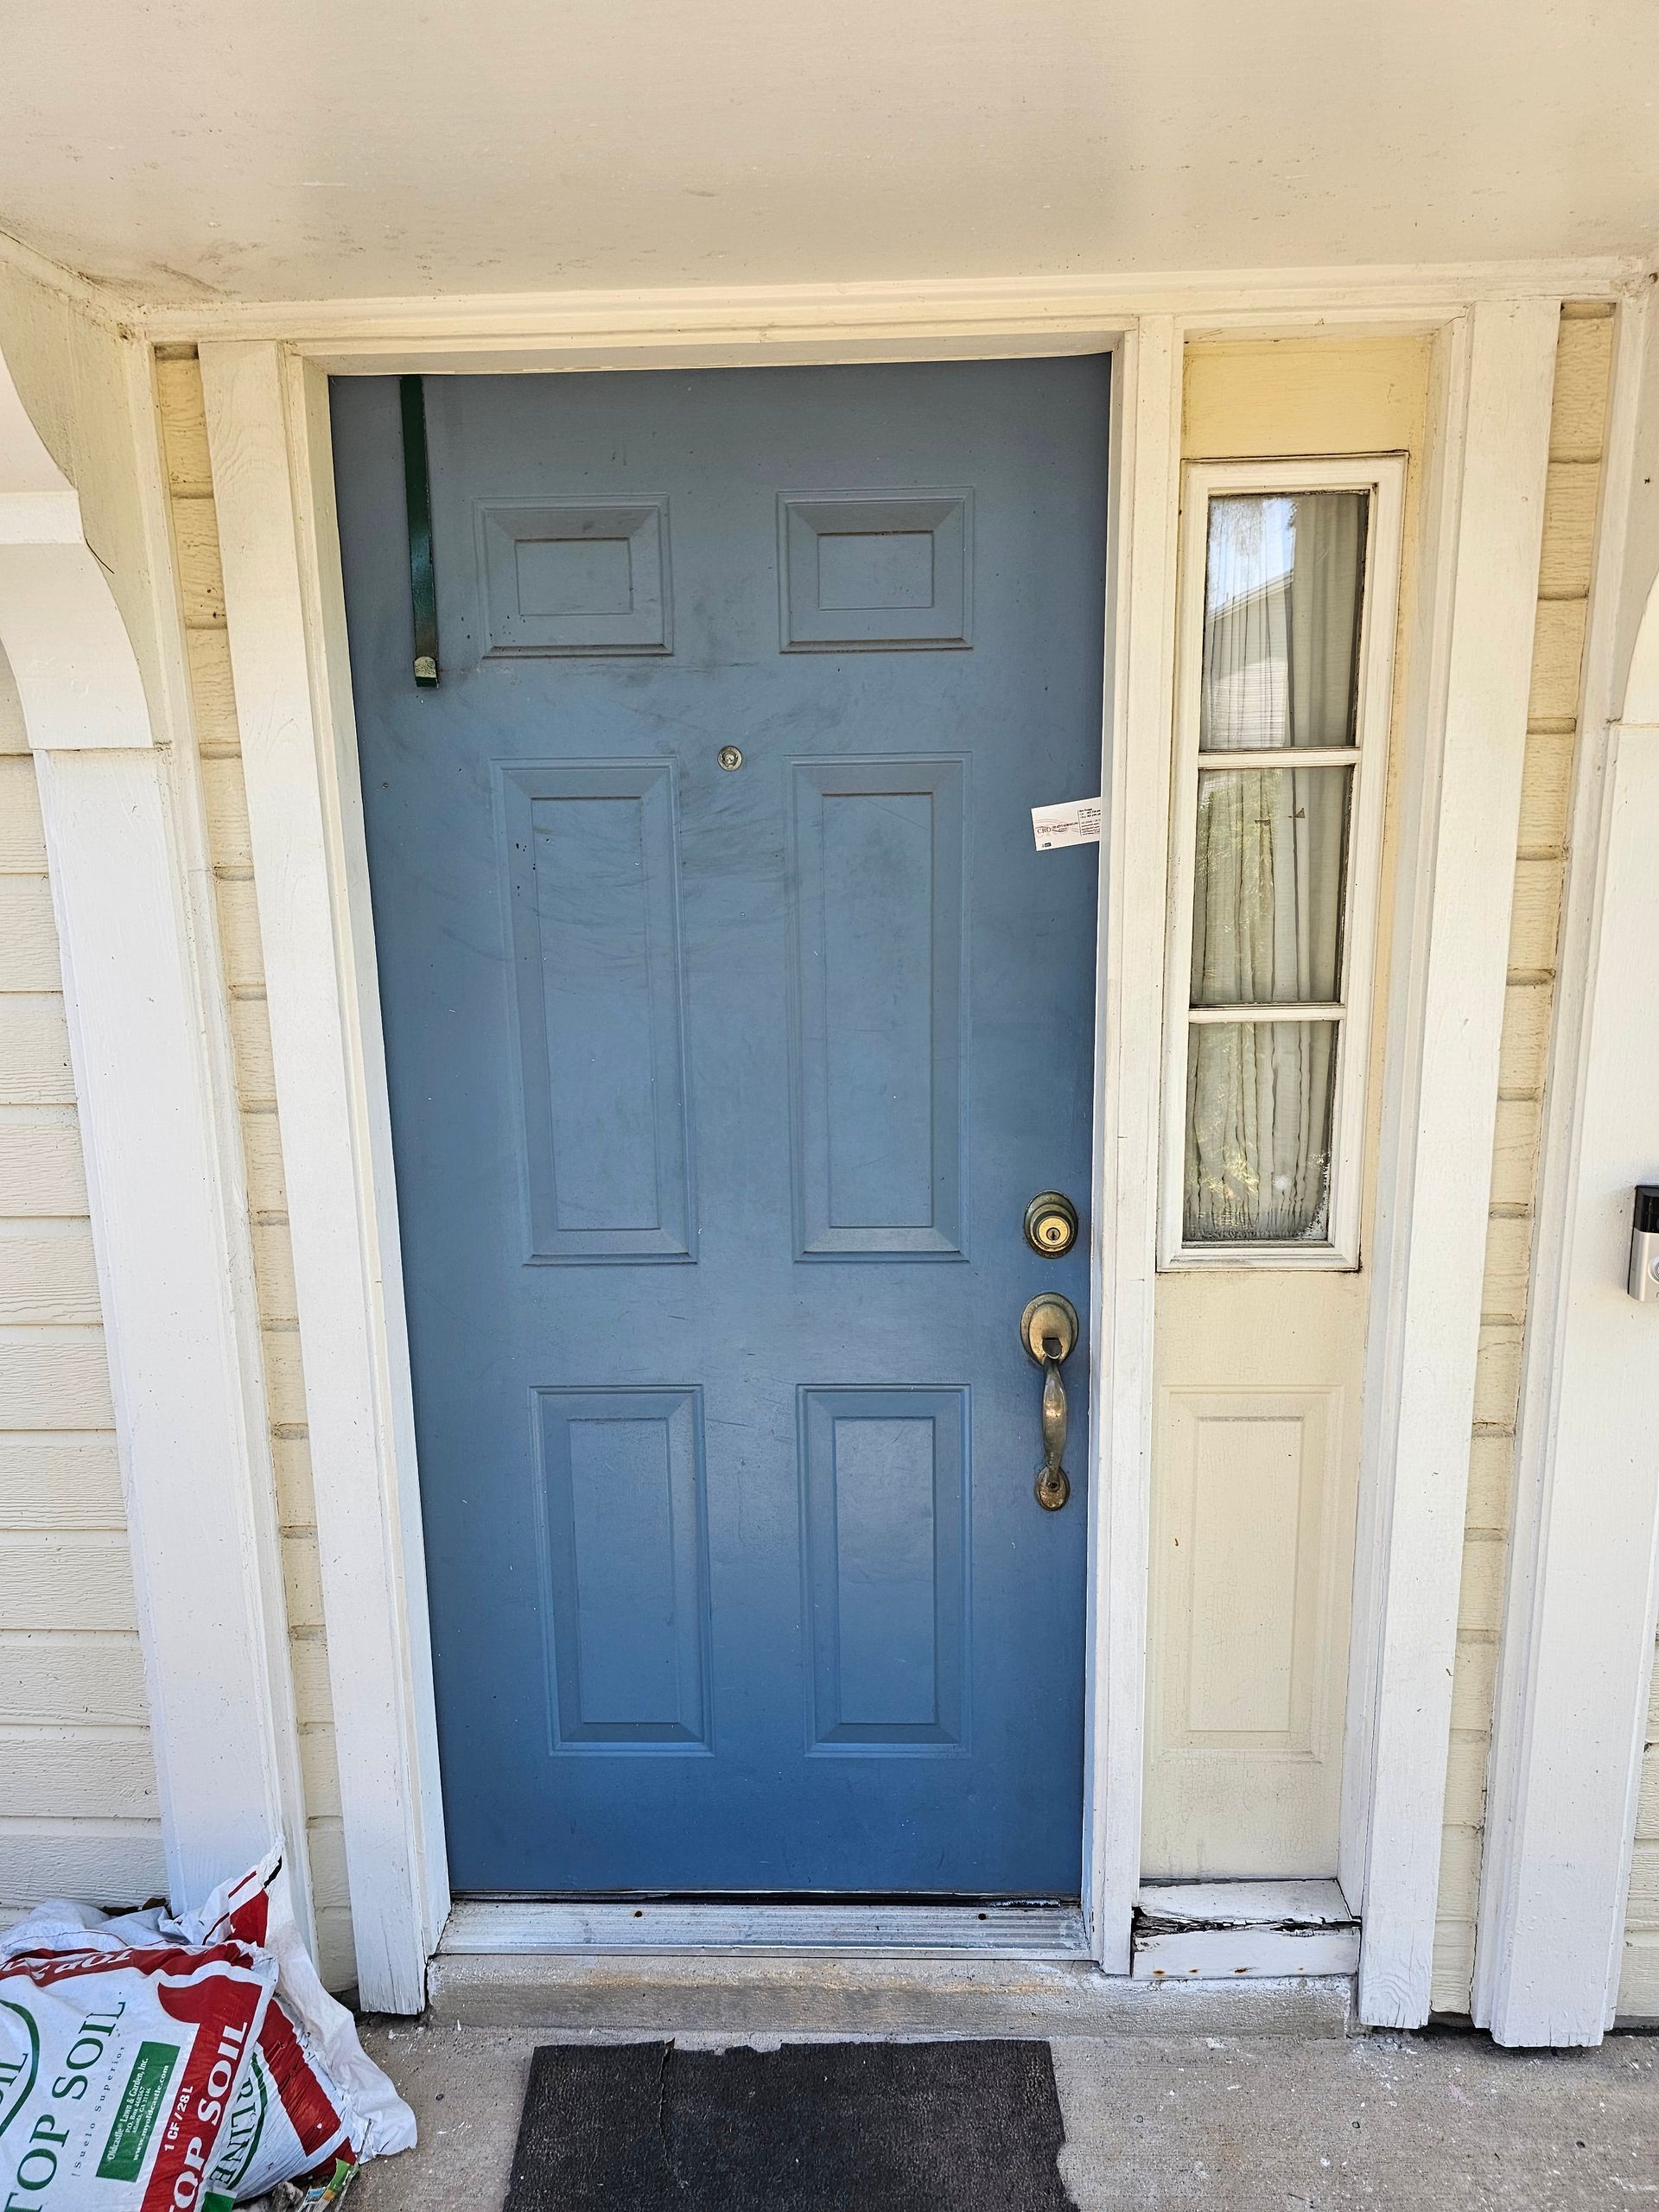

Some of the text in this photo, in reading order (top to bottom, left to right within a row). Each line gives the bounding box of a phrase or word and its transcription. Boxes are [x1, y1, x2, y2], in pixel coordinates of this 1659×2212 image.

[119, 2104, 132, 2122] Lawn
[137, 2057, 149, 2070] Inc.
[133, 2064, 169, 2161] www.myoldcastle.com
[197, 2022, 248, 2126] SOIL
[167, 2121, 180, 2140] CF
